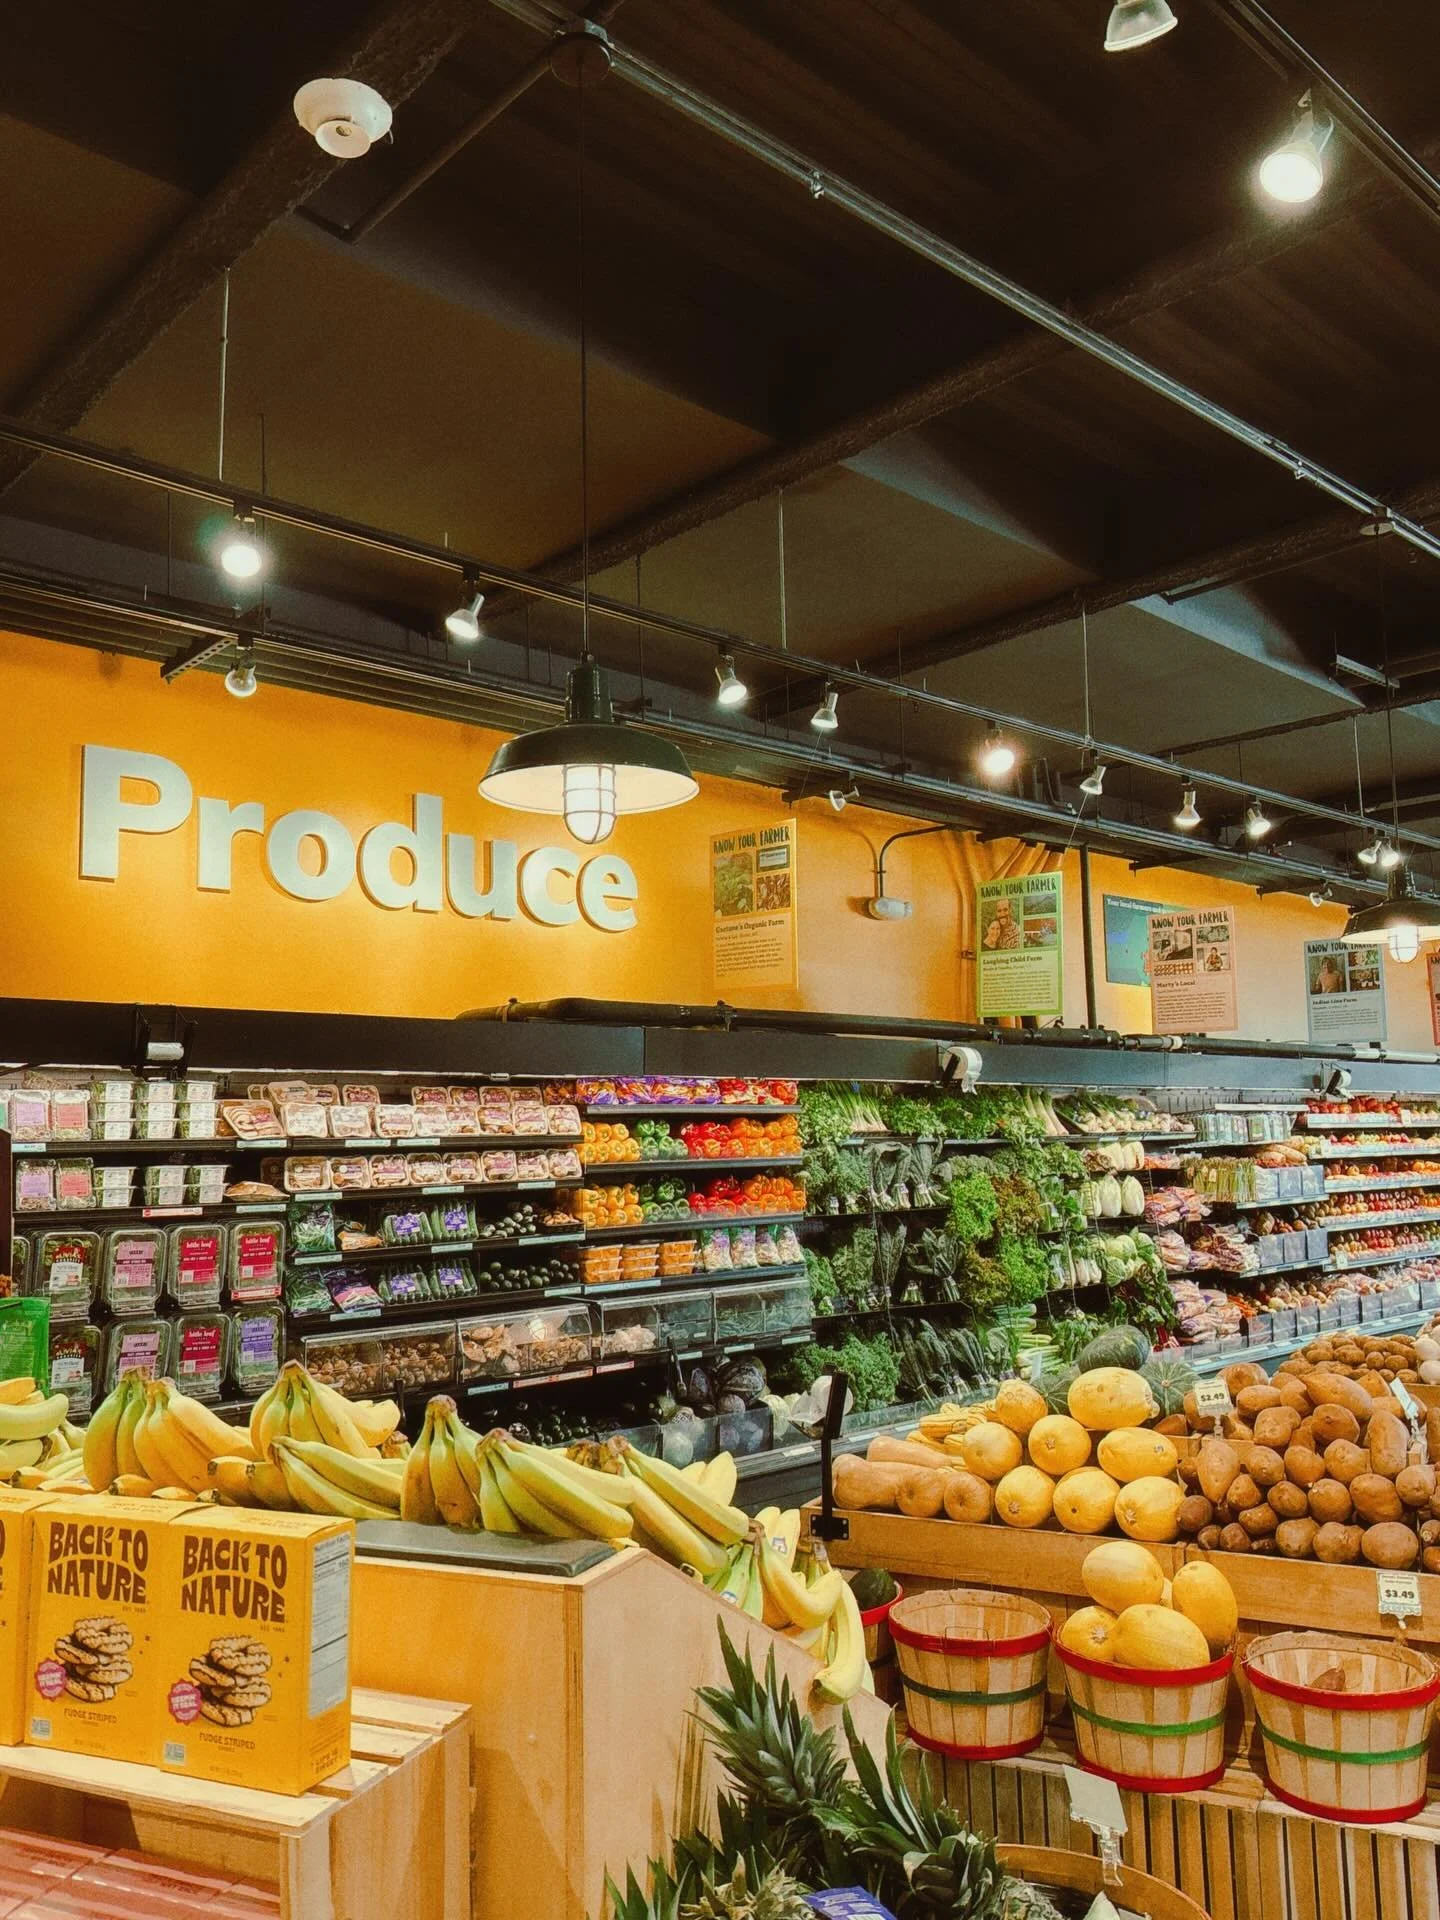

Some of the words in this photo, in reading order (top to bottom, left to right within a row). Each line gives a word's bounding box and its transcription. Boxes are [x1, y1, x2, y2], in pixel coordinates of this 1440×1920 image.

[79, 744, 639, 932] Produce
[713, 838, 735, 854] KNOW
[738, 832, 757, 850] YOUR
[760, 826, 790, 846] FARMER
[981, 885, 1002, 898] KNOW
[1006, 882, 1024, 896] YOUR
[1027, 878, 1057, 893] FARMER
[1152, 917, 1173, 929] KNOW
[1177, 915, 1196, 927] YOUR
[1199, 911, 1229, 925] FARMER
[1307, 943, 1328, 954] KNOW
[1200, 1393, 1225, 1402] $2.49
[49, 1522, 115, 1564] BACK
[118, 1528, 148, 1572] TO
[182, 1535, 251, 1579] BACK
[255, 1543, 287, 1589] TO
[47, 1559, 146, 1604] NATURE
[181, 1575, 285, 1623] NATURE
[1384, 1589, 1415, 1599] $3.49
[223, 1736, 257, 1750] STRIPED
